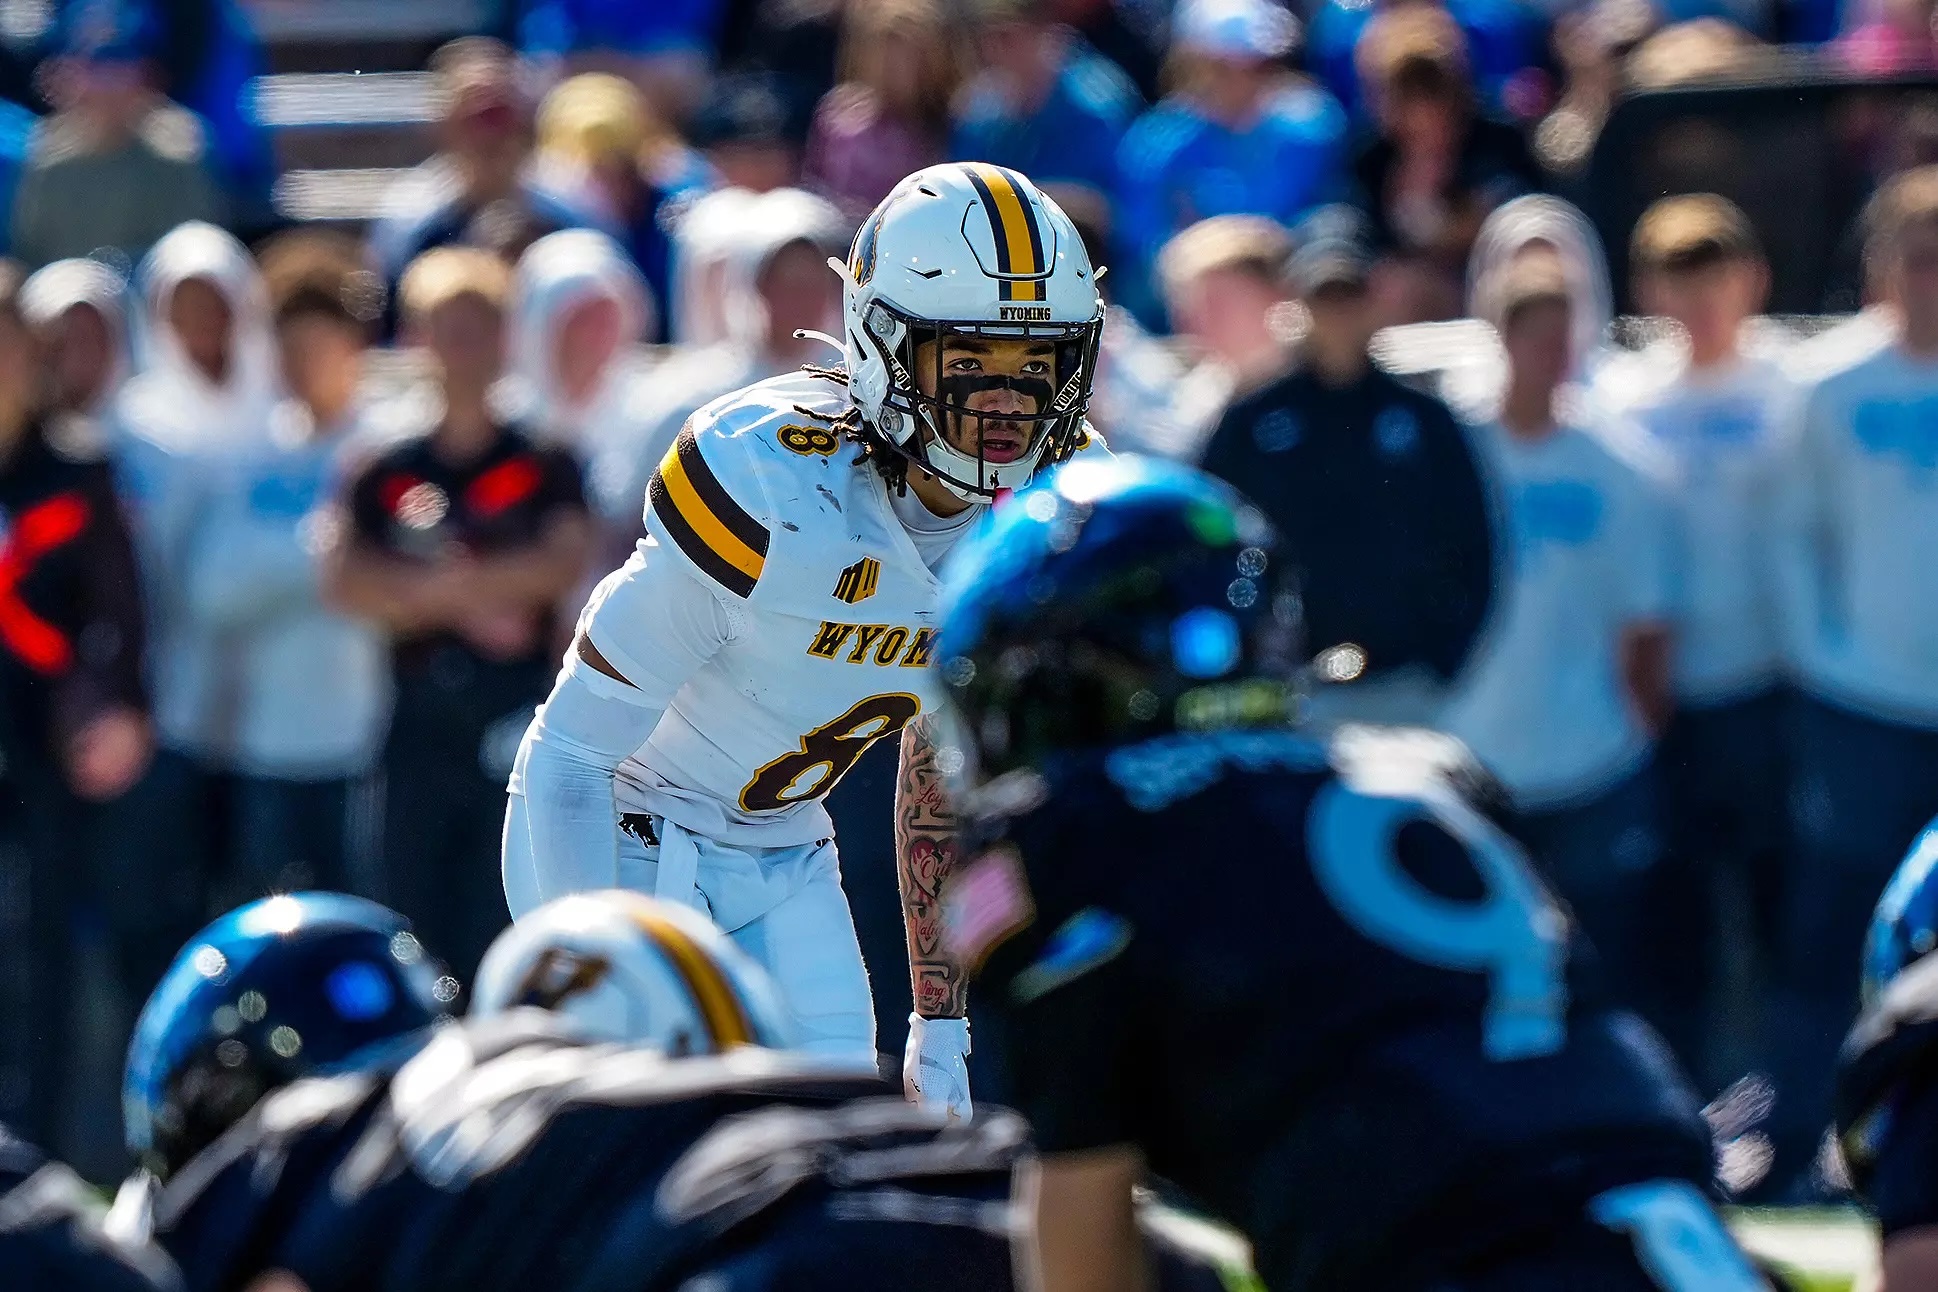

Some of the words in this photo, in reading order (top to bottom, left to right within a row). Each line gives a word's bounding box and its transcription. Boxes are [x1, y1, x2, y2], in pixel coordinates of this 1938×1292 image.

[999, 306, 1051, 321] WYOMING
[776, 423, 840, 457] 8
[806, 620, 943, 668] WYOM
[738, 691, 922, 812] 8
